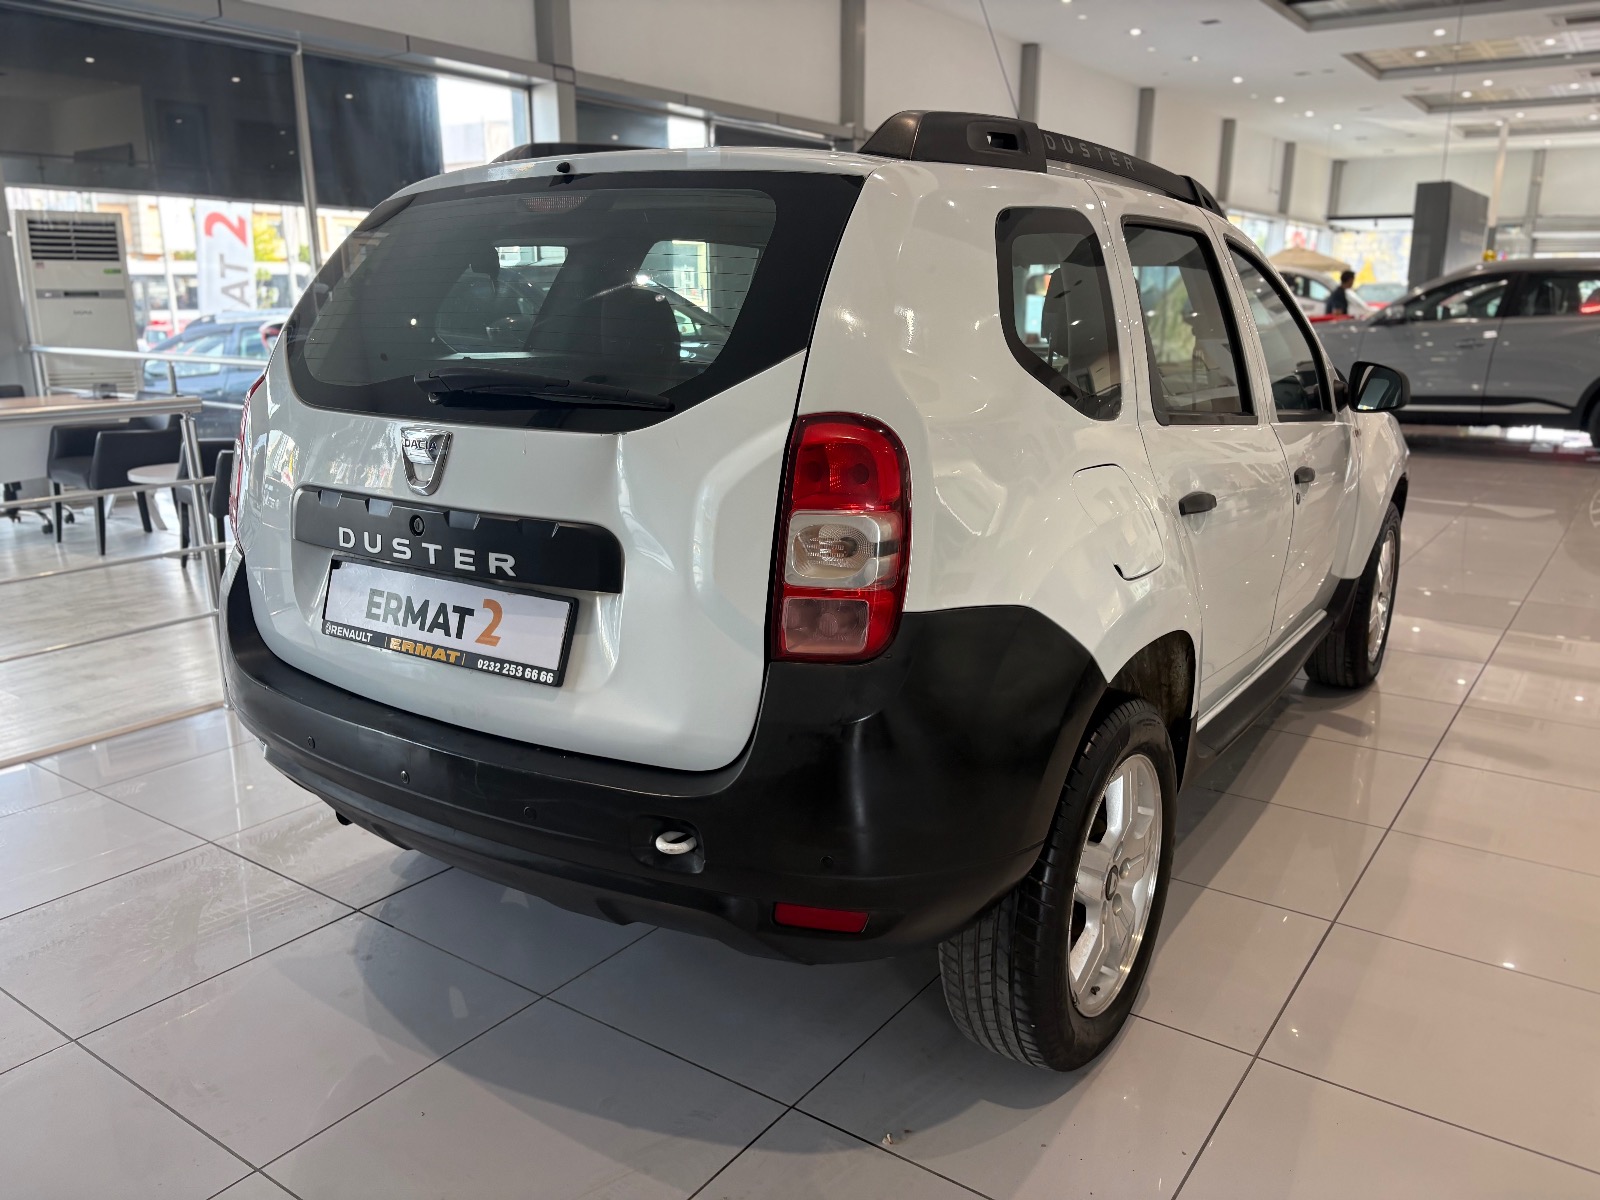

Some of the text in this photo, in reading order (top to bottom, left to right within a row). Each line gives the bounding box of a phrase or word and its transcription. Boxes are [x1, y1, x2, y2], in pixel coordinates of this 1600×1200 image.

[1043, 133, 1135, 172] DUSTER
[204, 212, 251, 312] AT 2
[404, 438, 438, 450] DACIA
[337, 526, 517, 577] DUSTER
[365, 588, 503, 647] ERMAT 2
[330, 625, 554, 684] RENAULT ERMAT 0232 253 66 66
